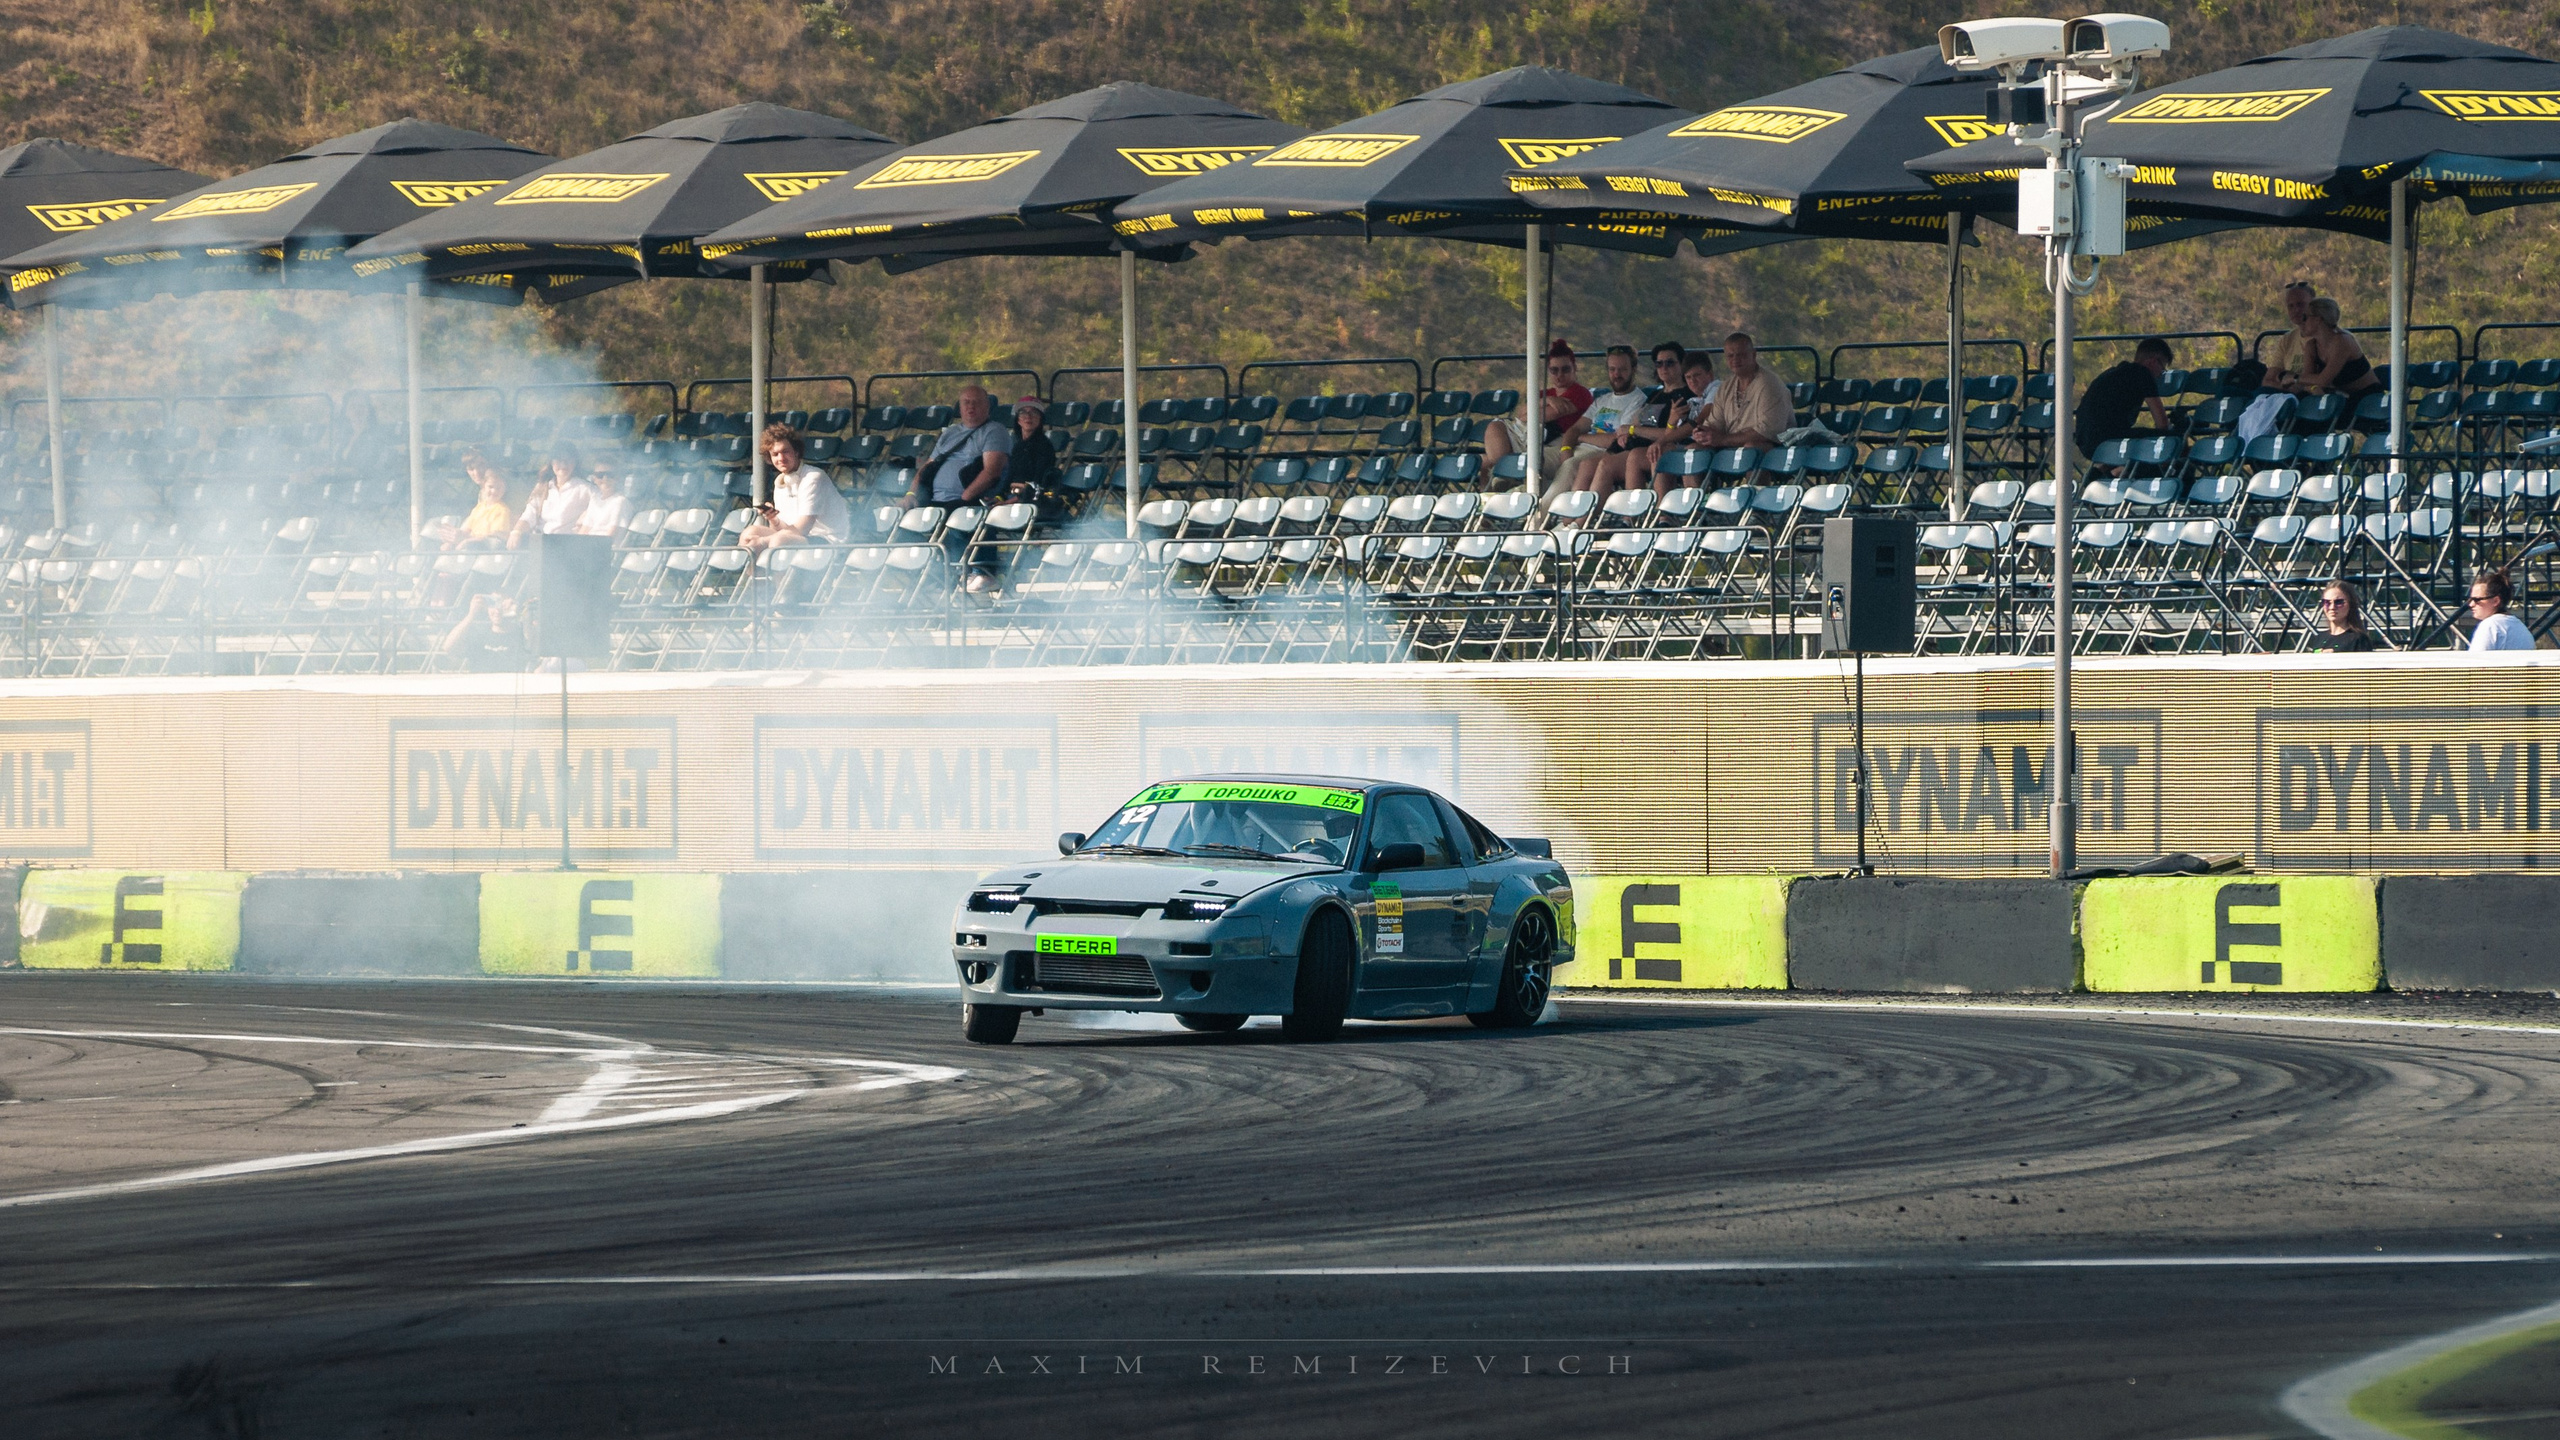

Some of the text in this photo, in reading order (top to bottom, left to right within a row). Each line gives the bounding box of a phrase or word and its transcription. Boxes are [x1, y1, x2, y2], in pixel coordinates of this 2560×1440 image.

[1605, 176, 1689, 197] ENERGY DRINK
[2212, 171, 2330, 200] ENERGY DRINK
[1708, 187, 1759, 206] ENERGY
[1193, 208, 1235, 225] ENERGY
[11, 266, 56, 292] ENERGY
[1154, 789, 1175, 801] 12
[1203, 788, 1297, 801] ГОРОШКО
[1118, 804, 1158, 826] 12
